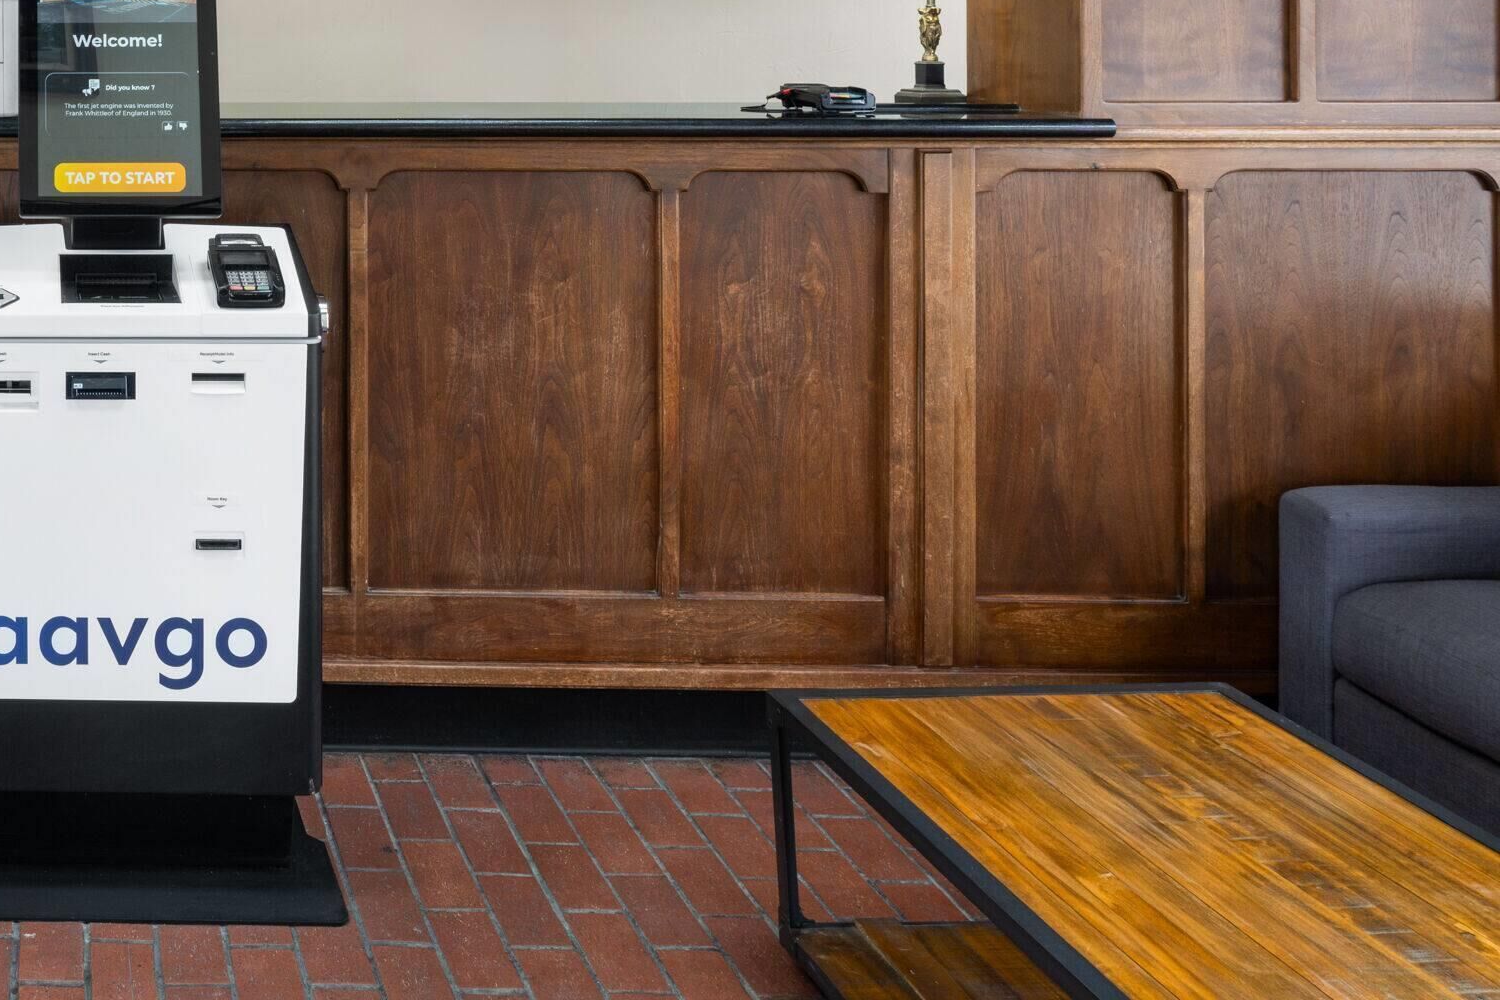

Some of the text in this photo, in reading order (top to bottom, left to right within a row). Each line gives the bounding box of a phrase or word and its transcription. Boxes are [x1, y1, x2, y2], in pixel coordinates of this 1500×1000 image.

[73, 34, 163, 48] Welcome!
[165, 102, 174, 110] by
[122, 110, 149, 118] England
[65, 172, 176, 184] TAP TO START
